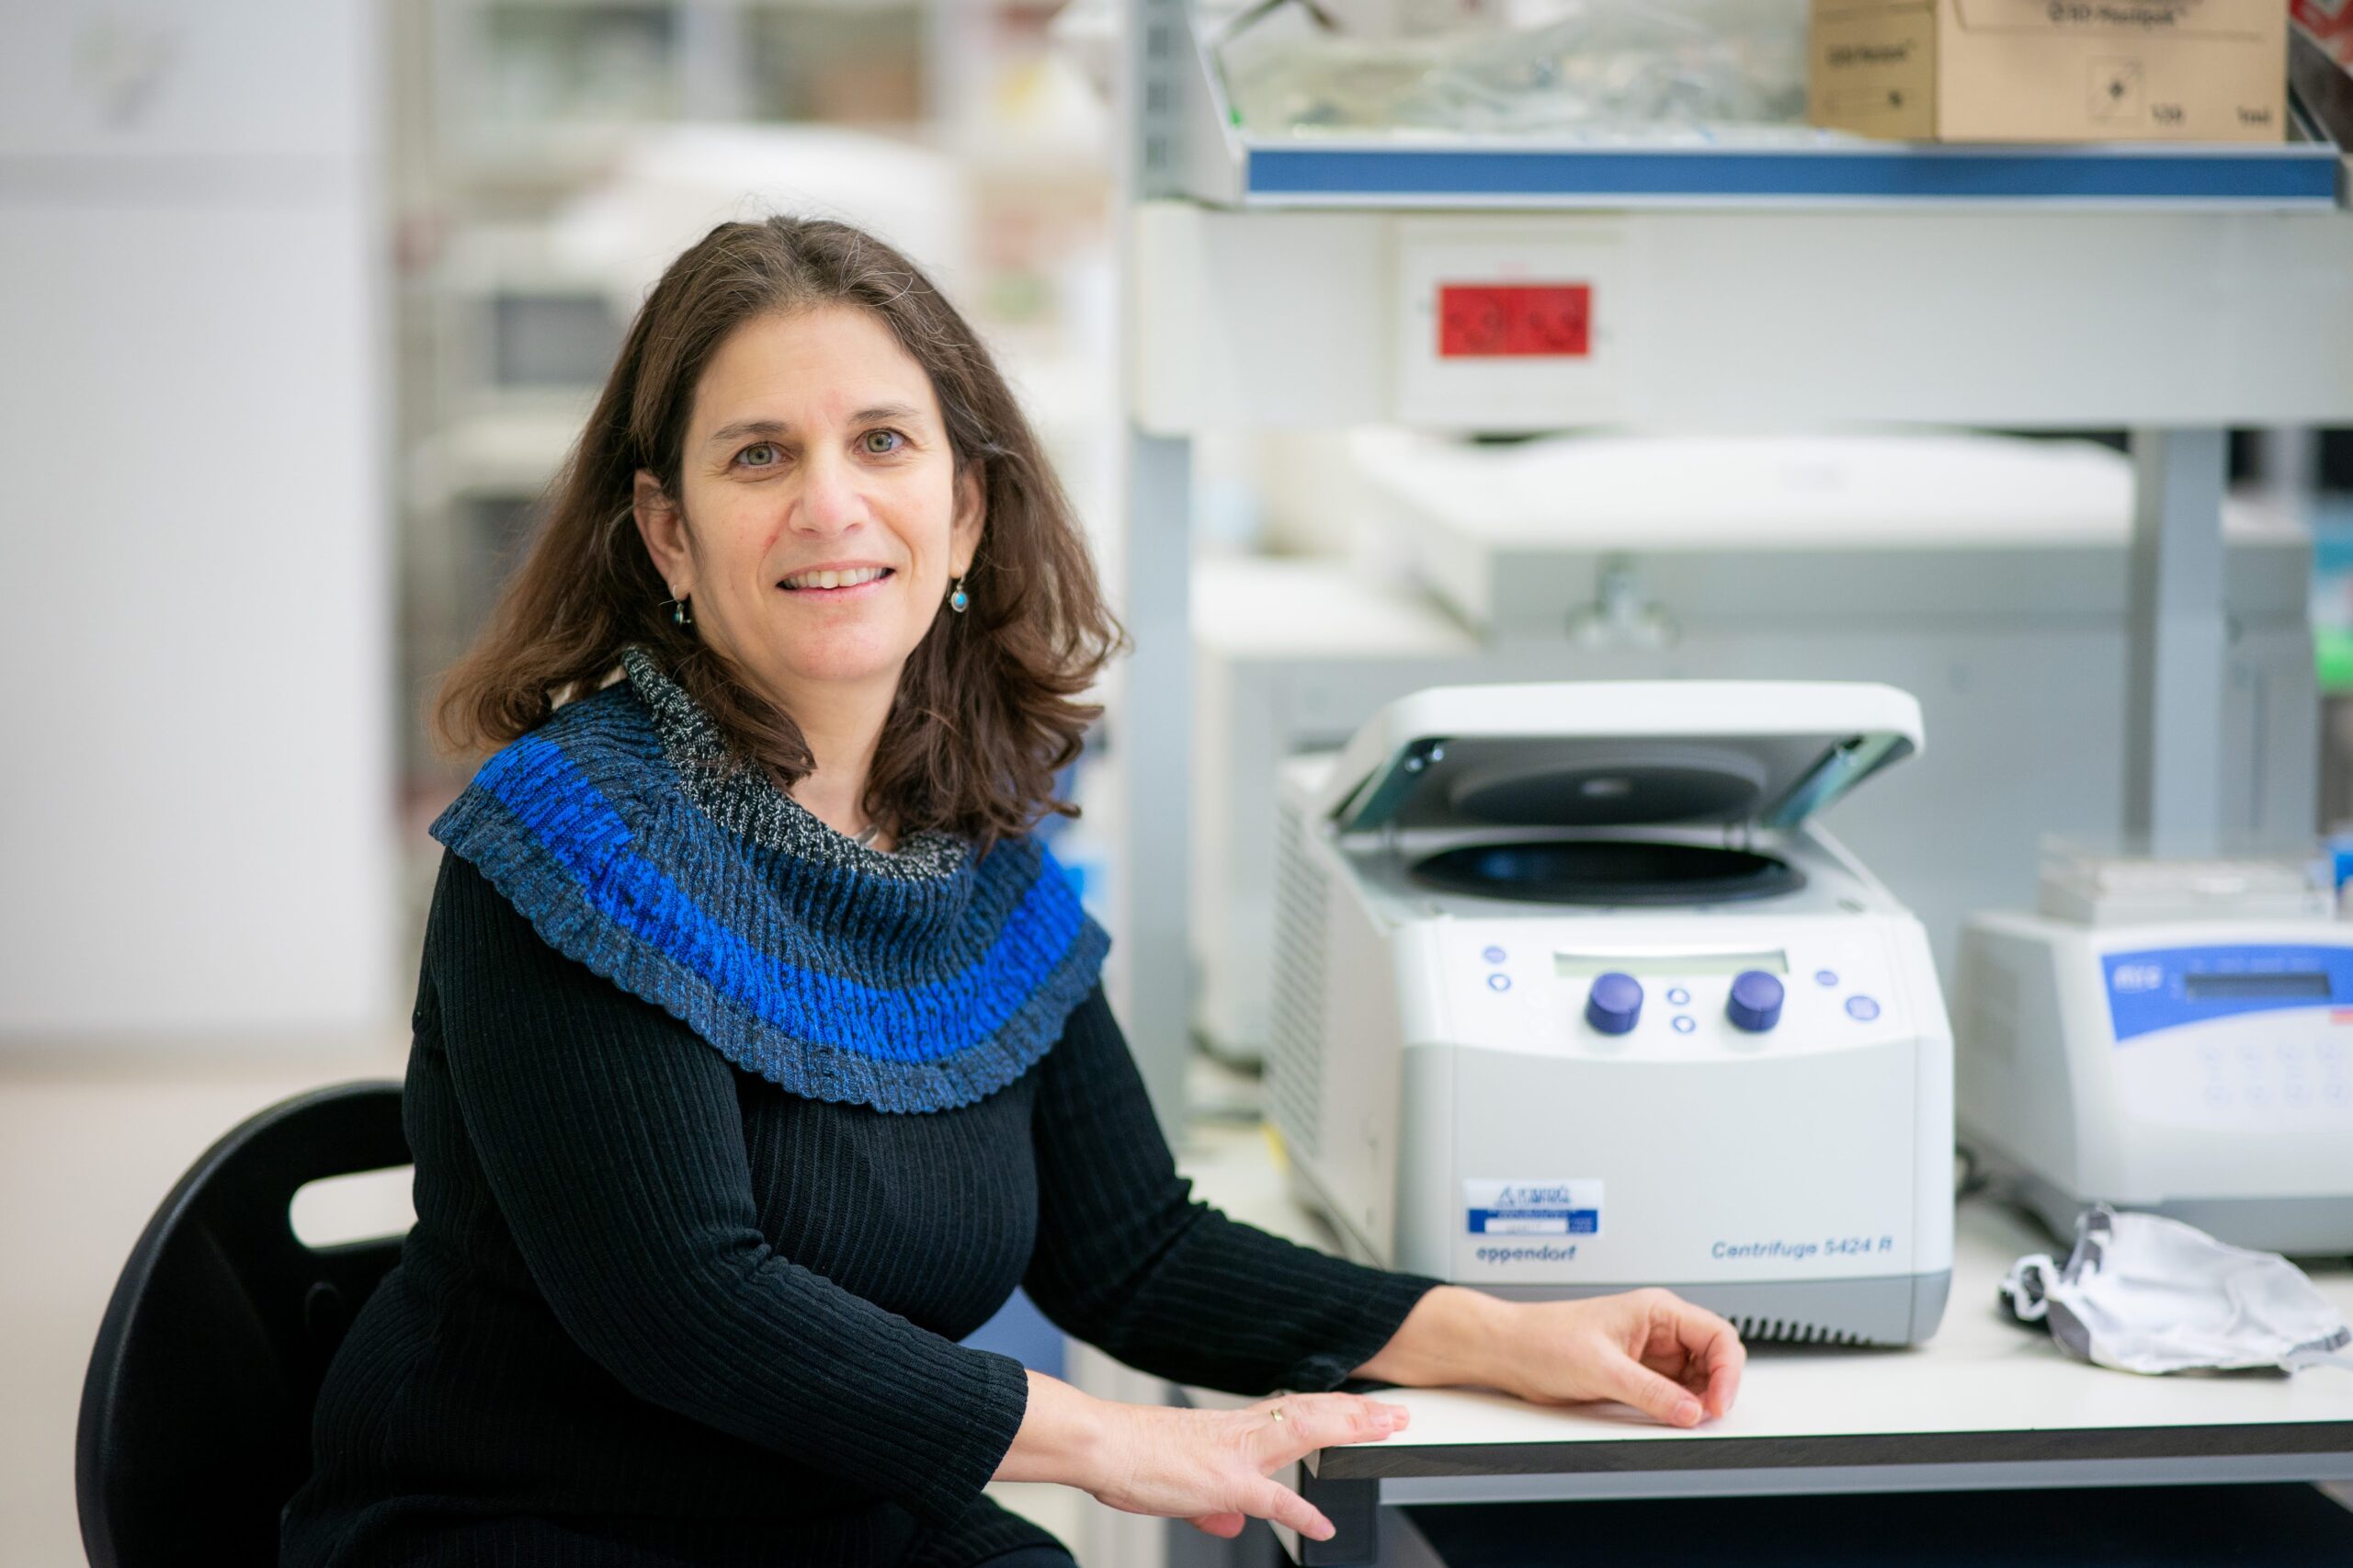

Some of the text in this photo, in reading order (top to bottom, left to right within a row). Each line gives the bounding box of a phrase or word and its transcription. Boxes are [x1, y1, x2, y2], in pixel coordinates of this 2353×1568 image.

[1475, 1244, 1577, 1264] eppendorf
[1711, 1234, 1893, 1260] Centrifuge 5424 R
